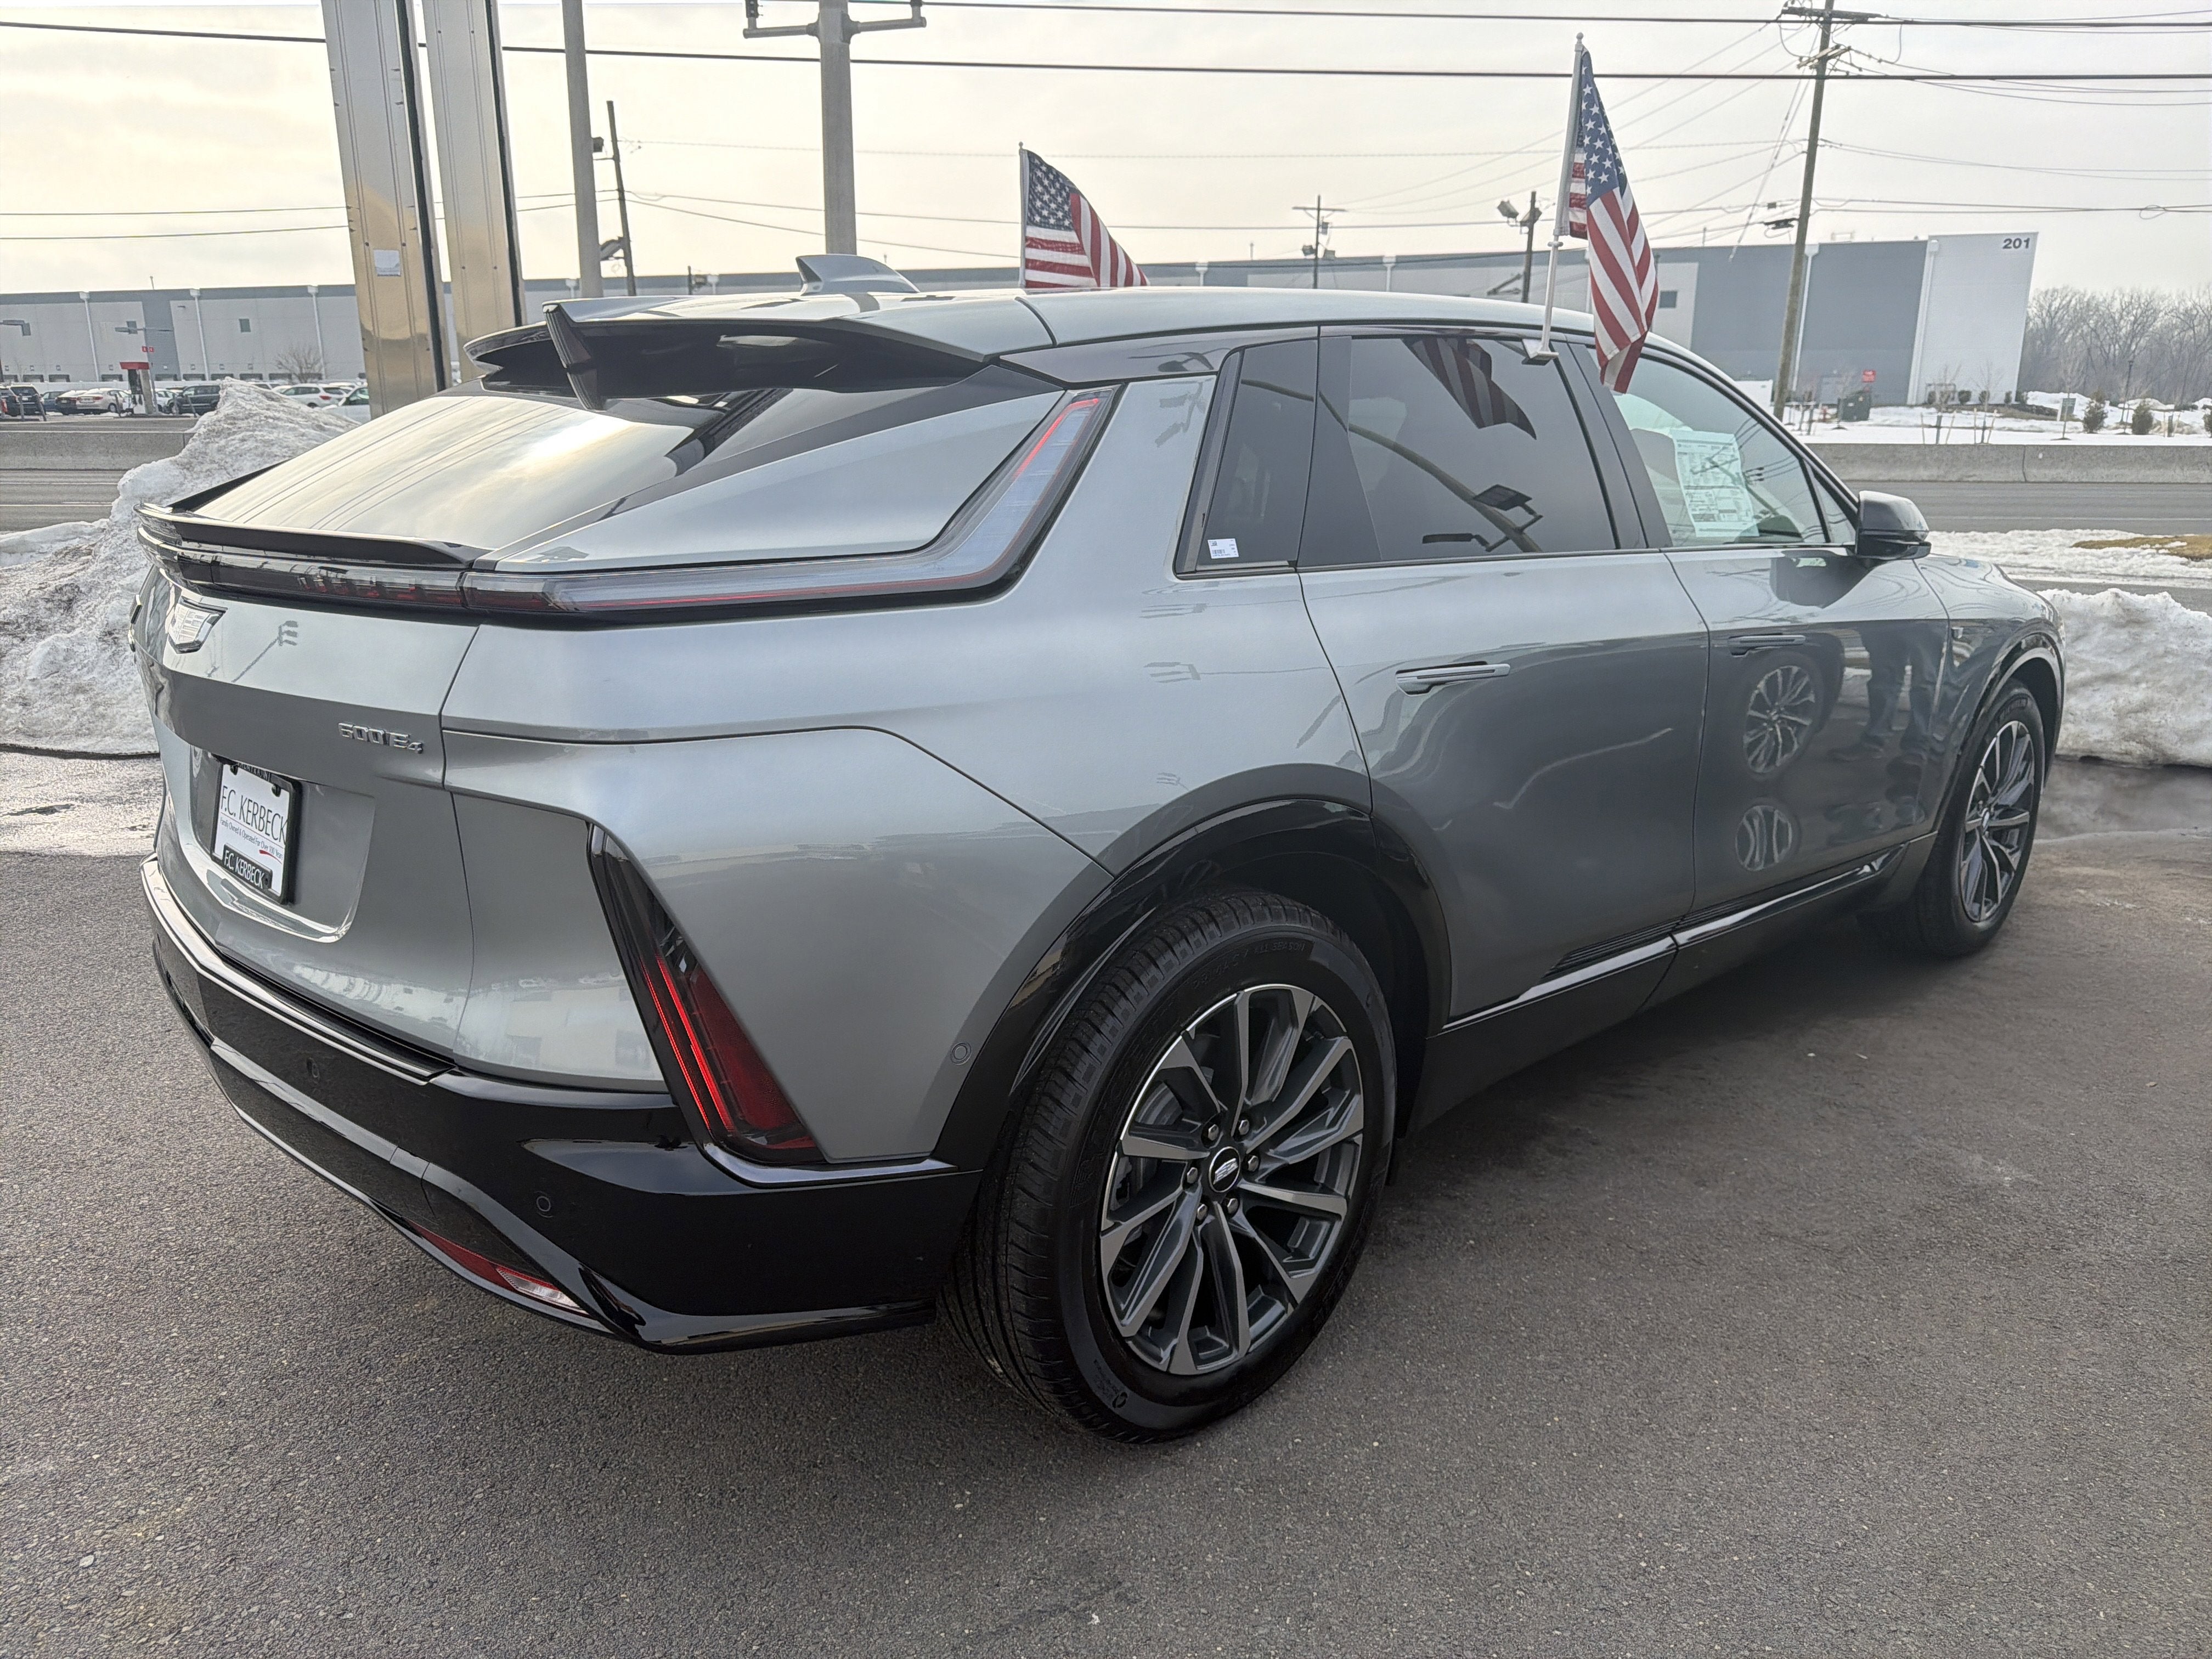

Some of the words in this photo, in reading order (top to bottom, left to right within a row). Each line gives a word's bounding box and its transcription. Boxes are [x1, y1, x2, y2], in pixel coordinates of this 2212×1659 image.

[2002, 238, 2030, 249] 201
[221, 786, 236, 817] F.C.
[239, 795, 288, 845] KERBECK
[224, 850, 234, 871] F.C.
[235, 856, 264, 889] KERBECK
[1272, 941, 1306, 951] SEASON
